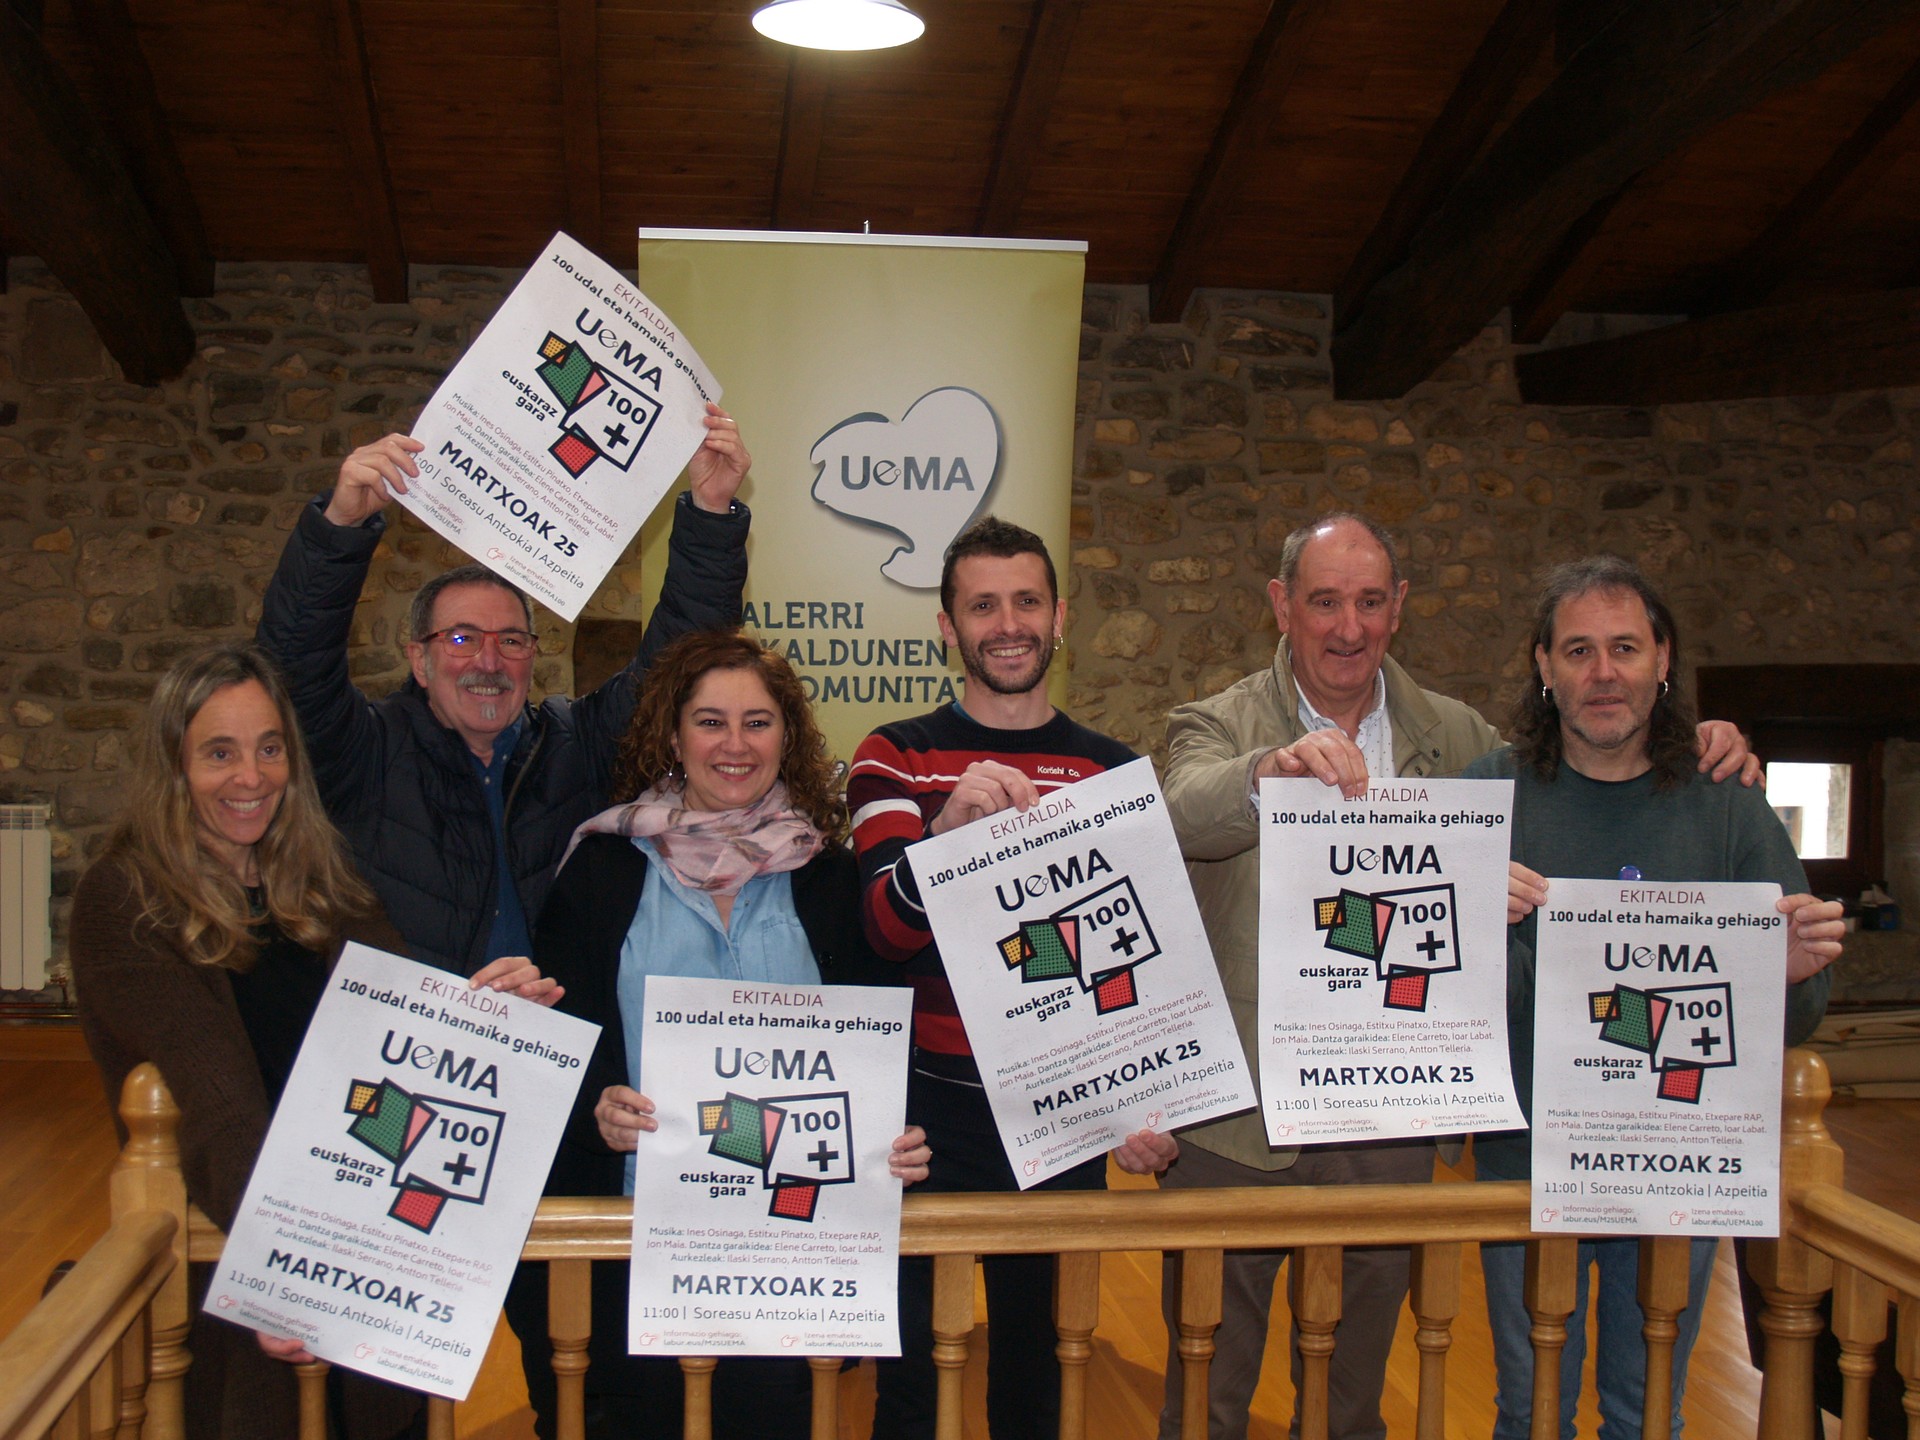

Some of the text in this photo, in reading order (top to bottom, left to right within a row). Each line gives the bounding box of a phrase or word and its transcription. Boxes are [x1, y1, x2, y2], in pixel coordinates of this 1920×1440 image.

[551, 254, 574, 274] 100
[574, 272, 603, 298] udal
[603, 296, 623, 315] eta
[623, 311, 674, 359] hamaika
[614, 283, 676, 341] EKITALDIA
[502, 371, 558, 418] euskaraz
[515, 396, 545, 422] gara
[607, 389, 647, 425] 100
[439, 440, 579, 557] MARTXOAK 25
[440, 476, 485, 516] Soreasu
[483, 513, 532, 553] Antzokia
[538, 554, 584, 589] Azpeitia
[1344, 788, 1429, 802] ITALDIA
[990, 797, 1076, 840] EKITALDIA
[1272, 810, 1505, 827] 100 udal eta hamaika gehiago
[929, 792, 1156, 887] 100 udal eta hamaika gehiago
[1620, 890, 1705, 904] EKITALDIA
[1083, 897, 1130, 932] 100
[1400, 902, 1447, 925] 100
[1549, 909, 1782, 930] 100 udal eta hamaika gehiago
[1299, 965, 1369, 977] euskaraz
[1328, 979, 1361, 992] gara
[420, 977, 508, 1020] EKITALDIA
[733, 990, 823, 1007] EKITALDIA
[1006, 986, 1074, 1019] euskaraz
[1675, 999, 1723, 1021] 100
[656, 1010, 905, 1035] 100 udal eta hamaika gehiago
[1037, 1000, 1071, 1022] gara
[339, 978, 581, 1069] 100 udal eta hamaika gehiago
[996, 990, 1207, 1077] Musika: Ines Osinaga, Estitxu Pinatxo, Etxepare RAP,
[998, 1000, 1214, 1089] Jon Maia. Dantza garaikidea: Elene Carreto, Ioar Labat.
[1025, 1020, 1195, 1091] Aurkezleak: Ilaski Serrano, Antton Telleria.
[1574, 1056, 1643, 1068] euskaraz
[1033, 1039, 1201, 1116] MARTXOAK 25
[1300, 1065, 1474, 1086] MARTXOAK 25
[1602, 1070, 1635, 1082] gara
[1016, 1059, 1235, 1147] 11:00 Soreasu Antzokia Azpeitia
[1276, 1092, 1505, 1110] 11:00 Soreasu Antzokia Azpeitia
[790, 1110, 841, 1133] 100
[1545, 1121, 1767, 1133] Jon Maia. Dantza garaikidea: Elene Carreto, Ioar Labat.
[1548, 1109, 1764, 1123] Musika: Ines Osinaga, Estitxu Pinatxo, Etxepare RAP,
[439, 1118, 489, 1147] 100
[1568, 1133, 1744, 1145] Aurkezleak: Ilaski Serrano, Antton Telleria.
[310, 1147, 386, 1178] euskaraz
[1571, 1152, 1742, 1174] MARTXOAK 25
[335, 1168, 373, 1188] gara
[680, 1171, 755, 1184] euskaraz
[710, 1186, 746, 1198] gara
[1545, 1182, 1767, 1199] 11:00 Soreasu Antzokia Azpeitia
[267, 1248, 455, 1324] MARTXOAK 25
[672, 1274, 857, 1297] MARTXOAK 25
[229, 1270, 471, 1357] 11:00 Soreasu Antzokia Azpeitia
[643, 1307, 885, 1324] 11:00 Soreasu Antzokia Azpeitia
